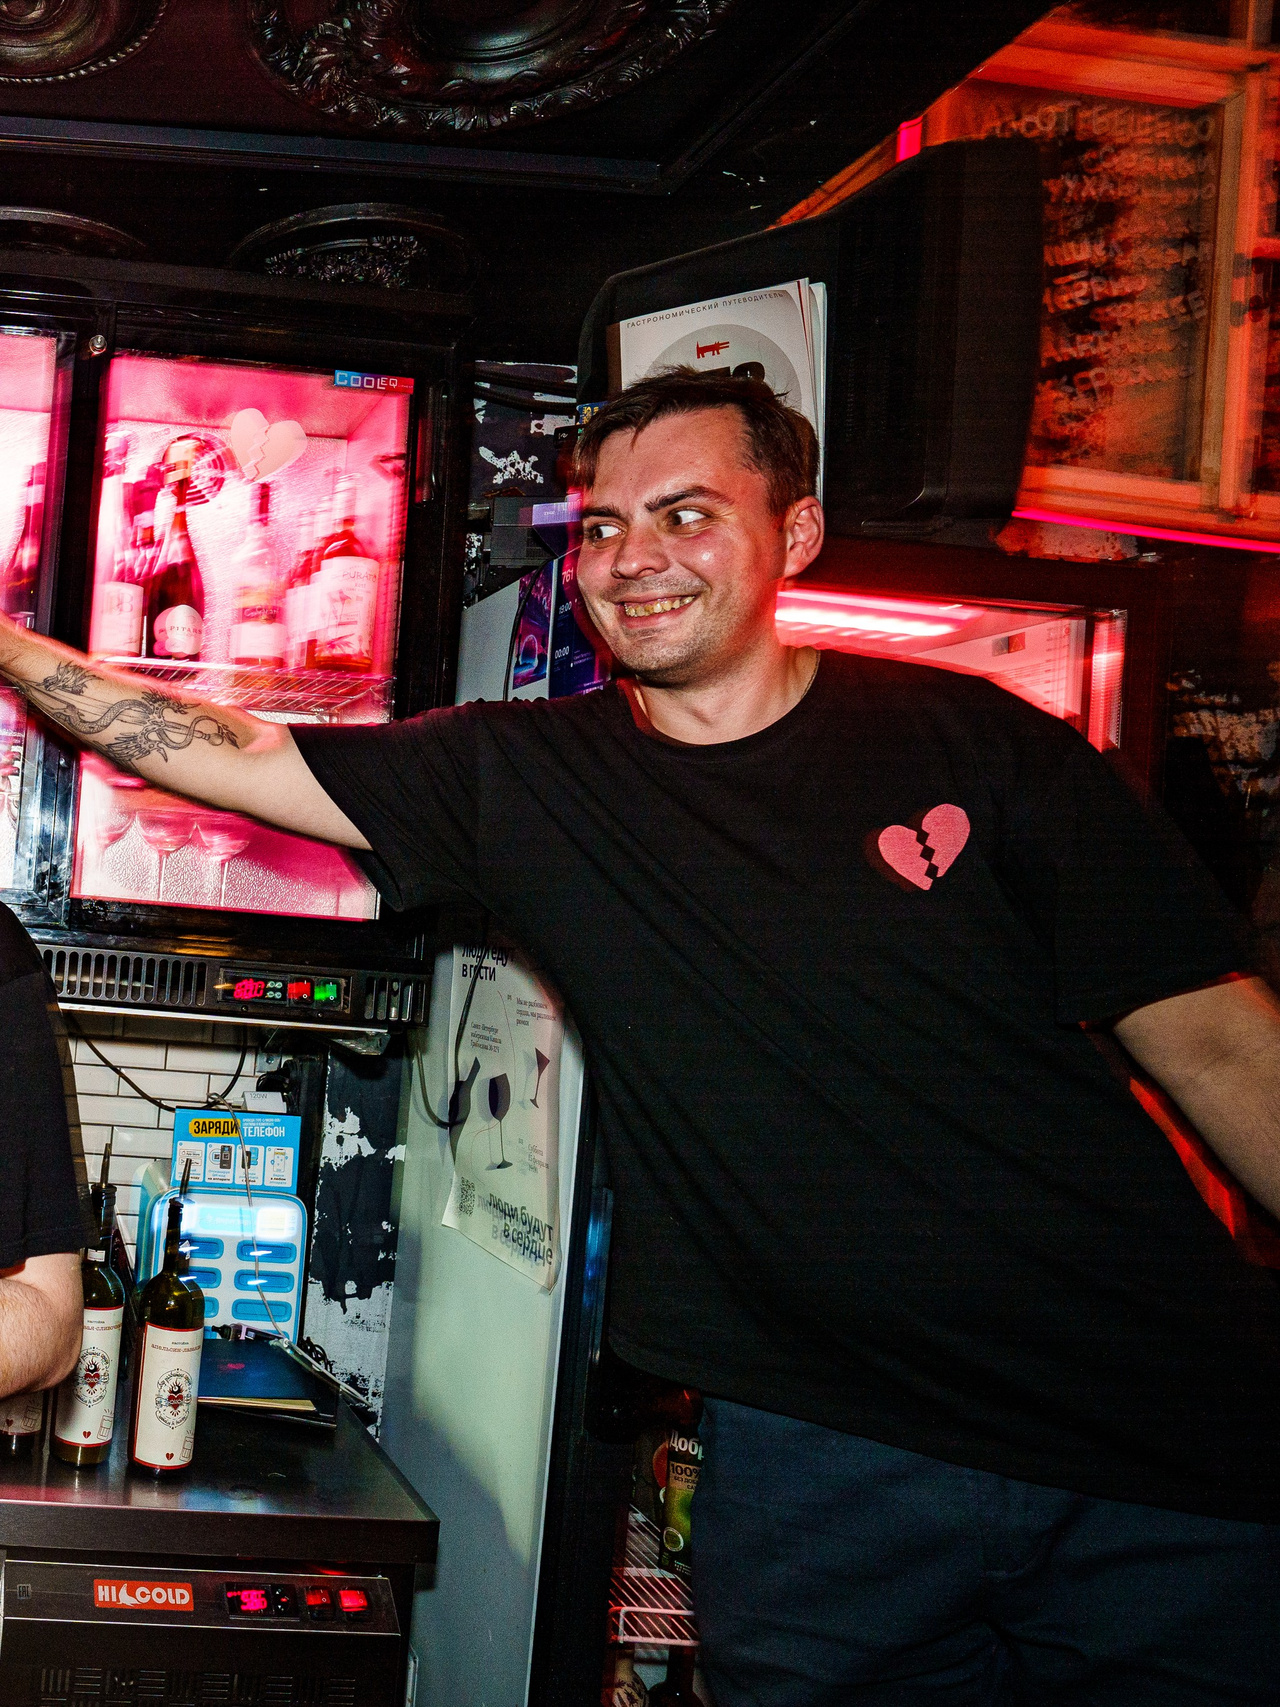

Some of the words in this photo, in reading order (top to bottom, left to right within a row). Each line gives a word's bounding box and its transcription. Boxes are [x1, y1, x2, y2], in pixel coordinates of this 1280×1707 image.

[626, 301, 719, 329] ГАСТРОНОМИЧЕСКИЙ
[722, 292, 784, 307] ПУТЕВОДИТЕЛЬ
[193, 1120, 239, 1136] ЗАРЯДИ
[242, 1126, 286, 1138] ТЕЛЕФОН
[489, 1193, 519, 1224] люди
[520, 1205, 554, 1243] будут
[503, 1222, 510, 1239] в
[511, 1227, 554, 1267] сердце
